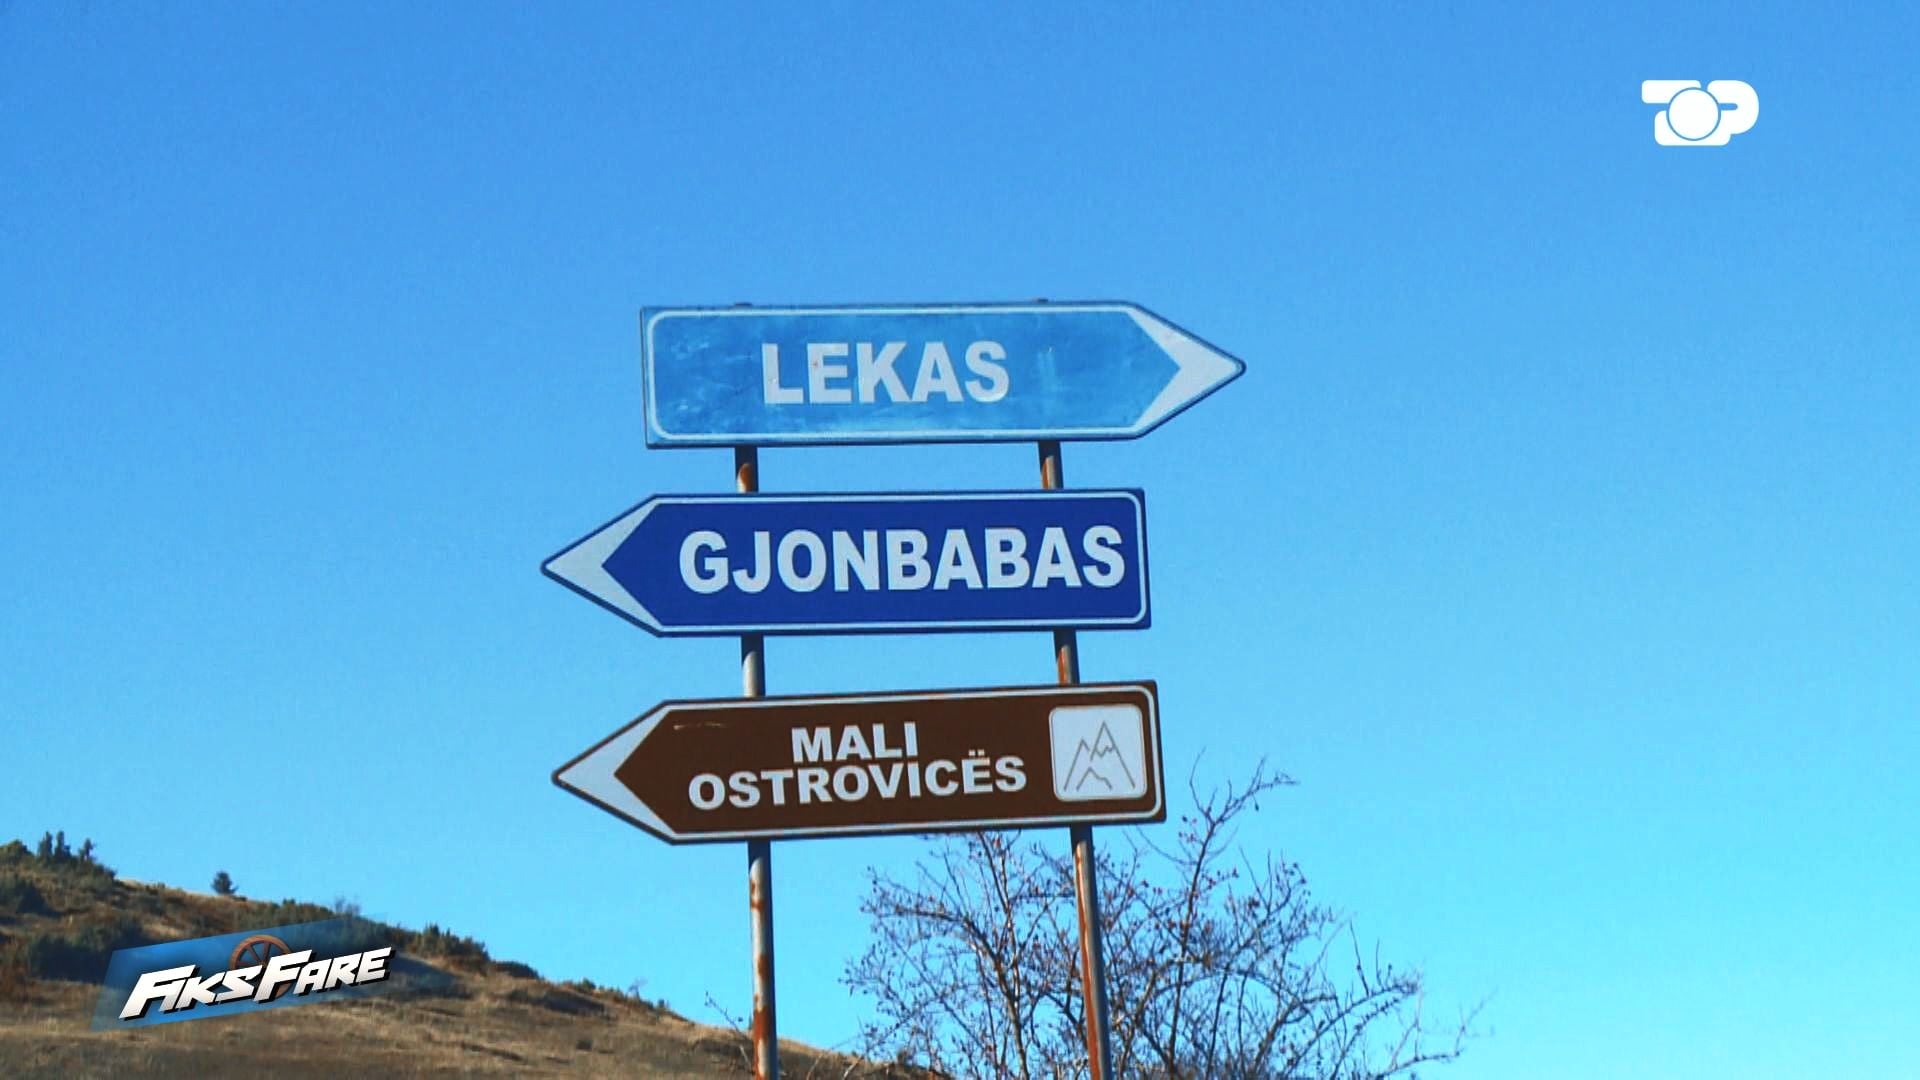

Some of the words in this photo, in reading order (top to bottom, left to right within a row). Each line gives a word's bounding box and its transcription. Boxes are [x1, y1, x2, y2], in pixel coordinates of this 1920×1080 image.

[761, 341, 1009, 404] LEKAS
[679, 525, 1125, 594] GJONBABAS
[790, 722, 919, 763] MALI
[688, 749, 1027, 810] OSTROVICËS
